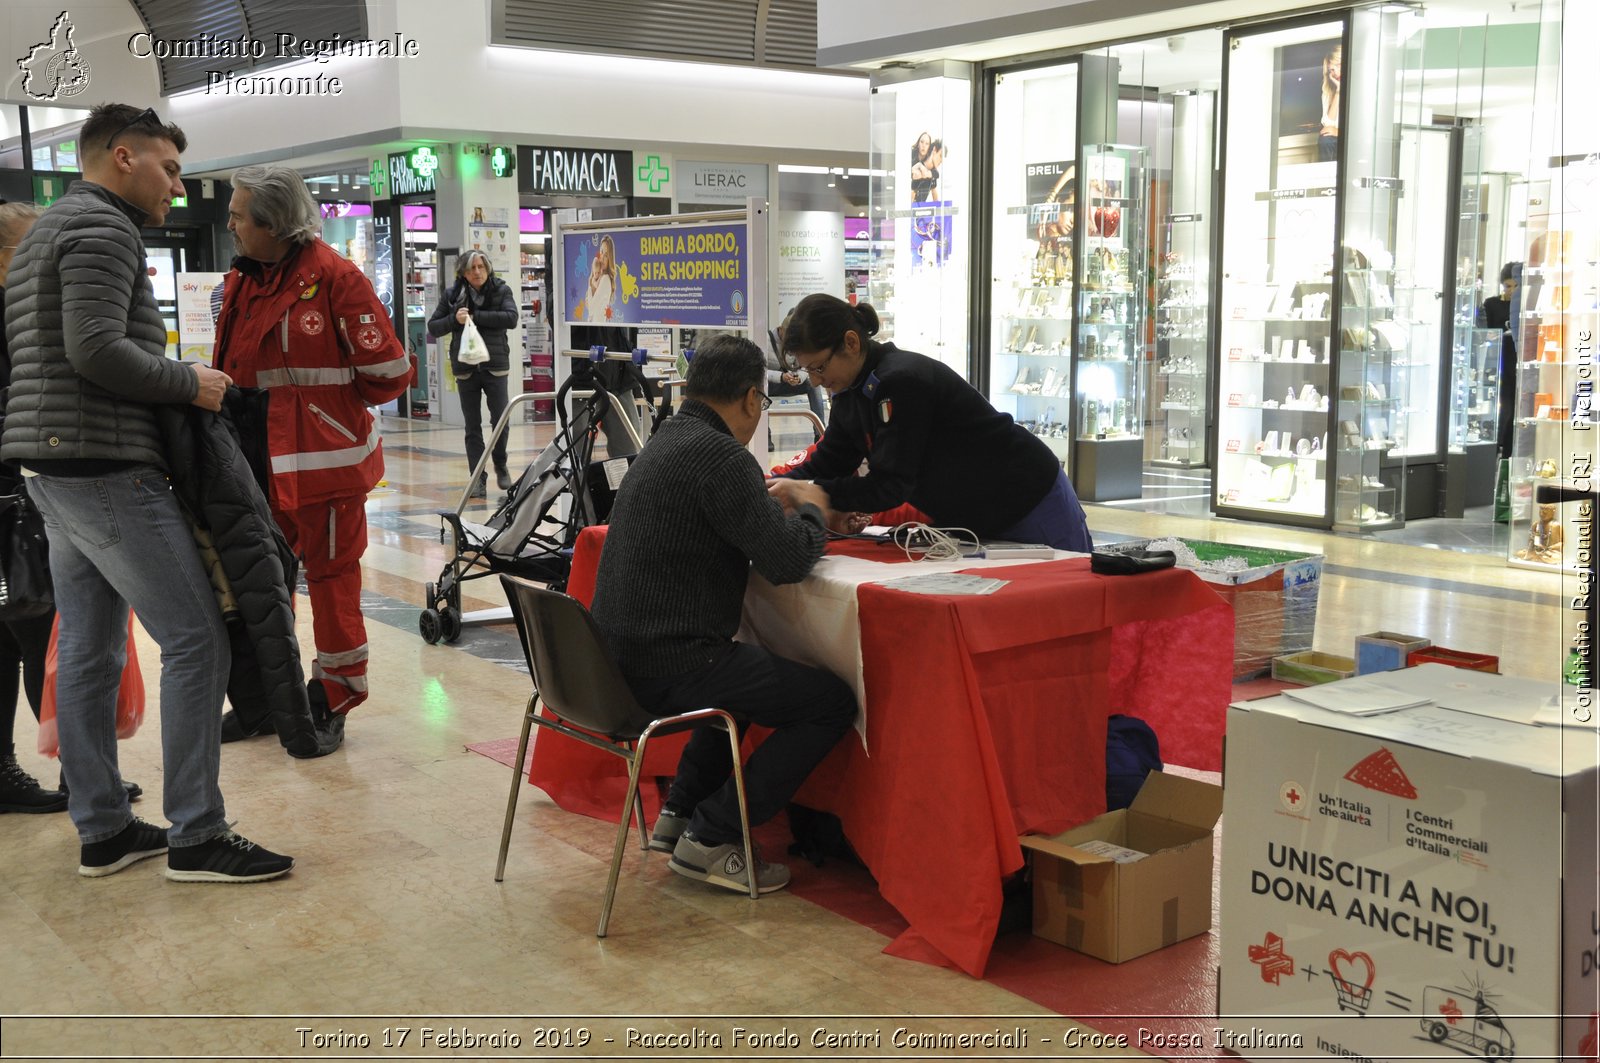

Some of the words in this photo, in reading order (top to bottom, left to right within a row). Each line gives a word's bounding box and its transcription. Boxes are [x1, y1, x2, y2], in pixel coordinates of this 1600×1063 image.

[533, 149, 619, 192] FARMACIA
[695, 173, 746, 188] LIERAC
[1028, 165, 1064, 176] BREIL
[640, 235, 674, 256] BIMBI
[677, 234, 686, 254] A
[687, 232, 739, 256] BORDO,
[640, 262, 650, 281] SI
[653, 262, 668, 280] FA
[670, 260, 739, 280] SHOPPING!
[183, 283, 198, 292] sky
[1319, 793, 1372, 815] Un'Italia
[1319, 805, 1338, 819] che
[1340, 809, 1372, 827] aiuta
[1405, 808, 1410, 819] I
[1413, 811, 1453, 830] Centri
[1406, 823, 1488, 853] Commerciali
[1406, 836, 1450, 857] d'Italia
[1268, 842, 1390, 898] UNISCITI
[1398, 879, 1421, 908] A
[1431, 886, 1497, 936] NOI,
[1251, 869, 1338, 916] DONA
[1345, 898, 1454, 953] ANCHE
[1463, 931, 1516, 974] TU!
